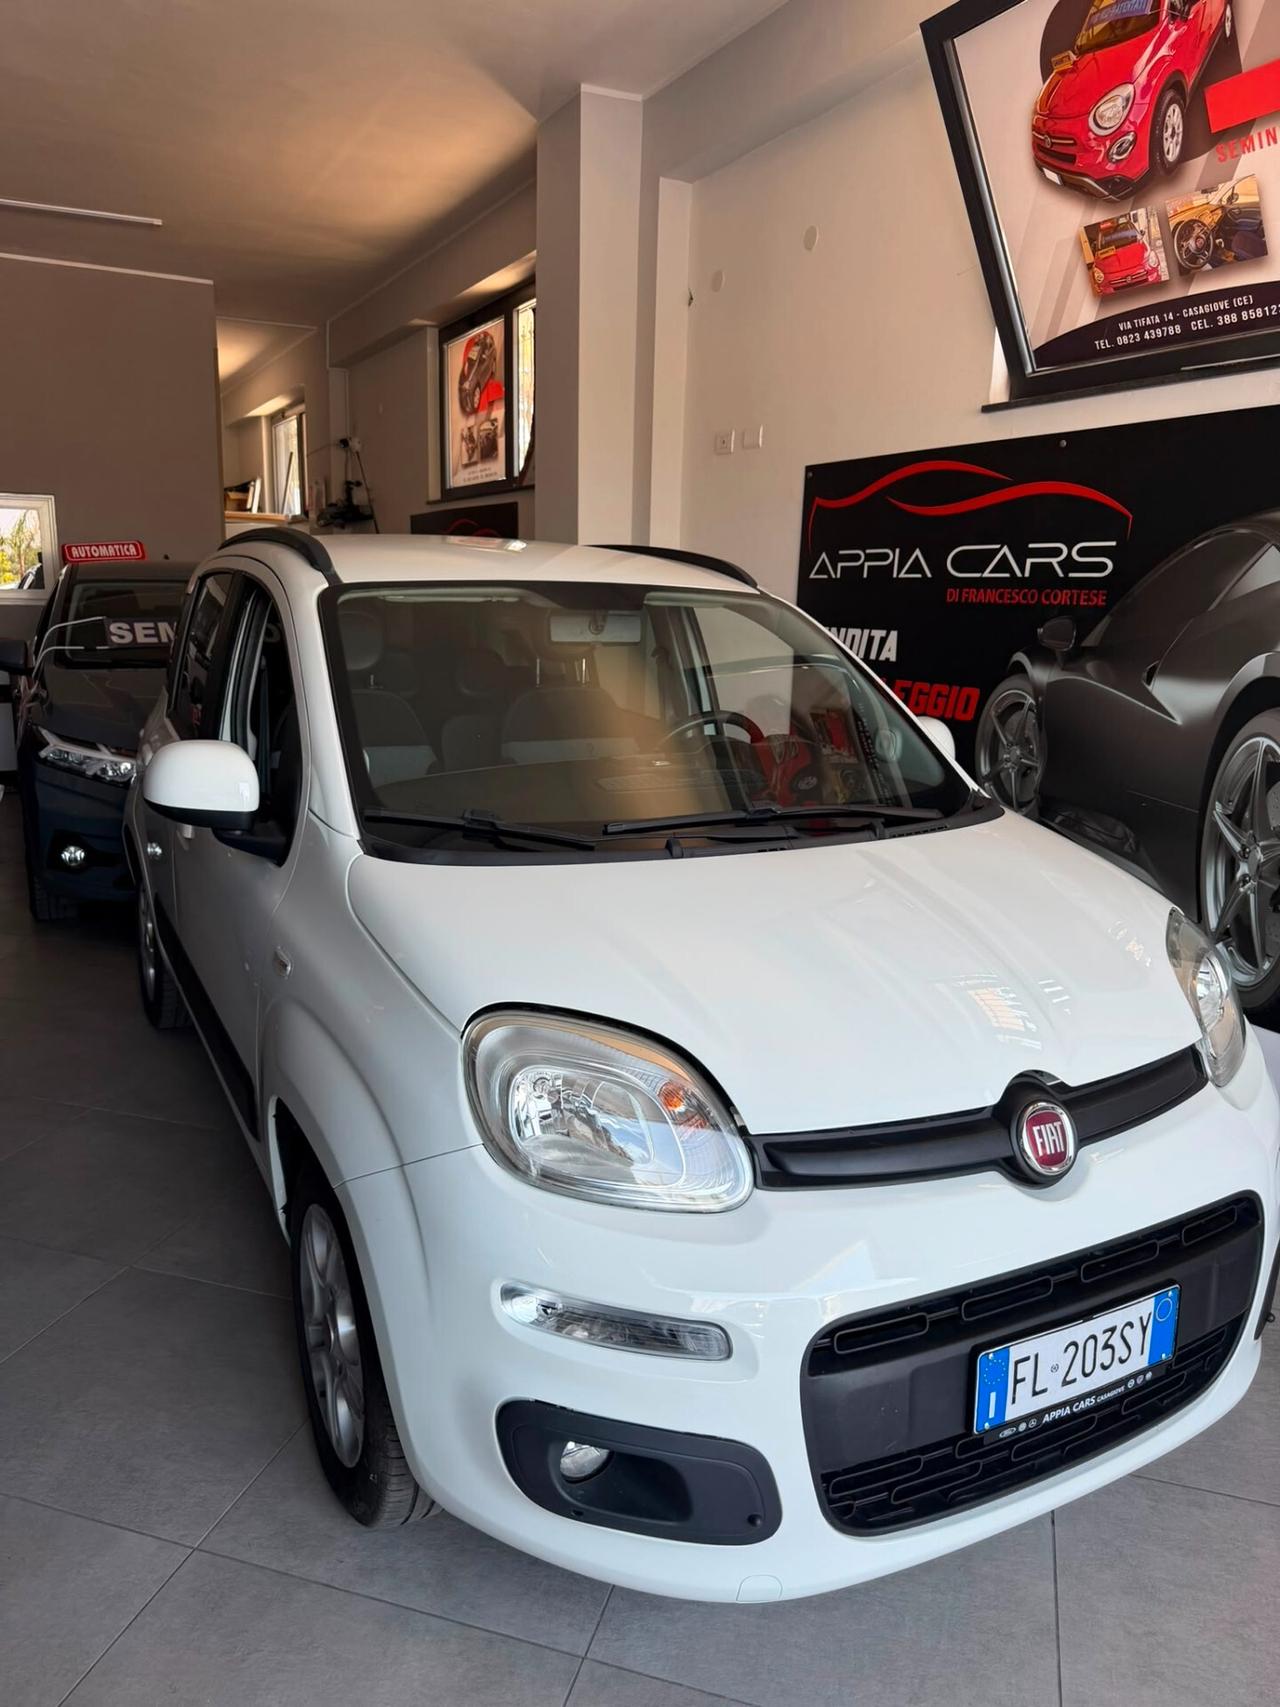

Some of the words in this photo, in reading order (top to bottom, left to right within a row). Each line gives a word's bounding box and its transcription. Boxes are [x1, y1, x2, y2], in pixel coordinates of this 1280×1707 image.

[1094, 338, 1114, 350] TEL.
[1116, 333, 1140, 346] 0823
[1144, 325, 1181, 341] 439788
[1190, 319, 1213, 331] CEL.
[1216, 311, 1237, 326] 388
[1241, 303, 1280, 320] 85812
[1118, 322, 1132, 331] VIA
[1134, 314, 1160, 328] TIFATA
[1163, 313, 1174, 322] 14
[1182, 301, 1230, 318] CASAGIOVE
[71, 544, 137, 558] AUTOMATICA
[809, 548, 932, 579] APPIA
[946, 541, 1117, 578] CARS
[946, 588, 959, 603] DI
[961, 588, 1039, 604] FRANCESCO
[1041, 588, 1107, 606] CORTESE
[1032, 1121, 1065, 1157] FIAT
[1011, 1352, 1048, 1405] FL
[1061, 1312, 1152, 1387] 203SY
[1042, 1406, 1071, 1424] APPIA
[1072, 1395, 1097, 1412] CARS
